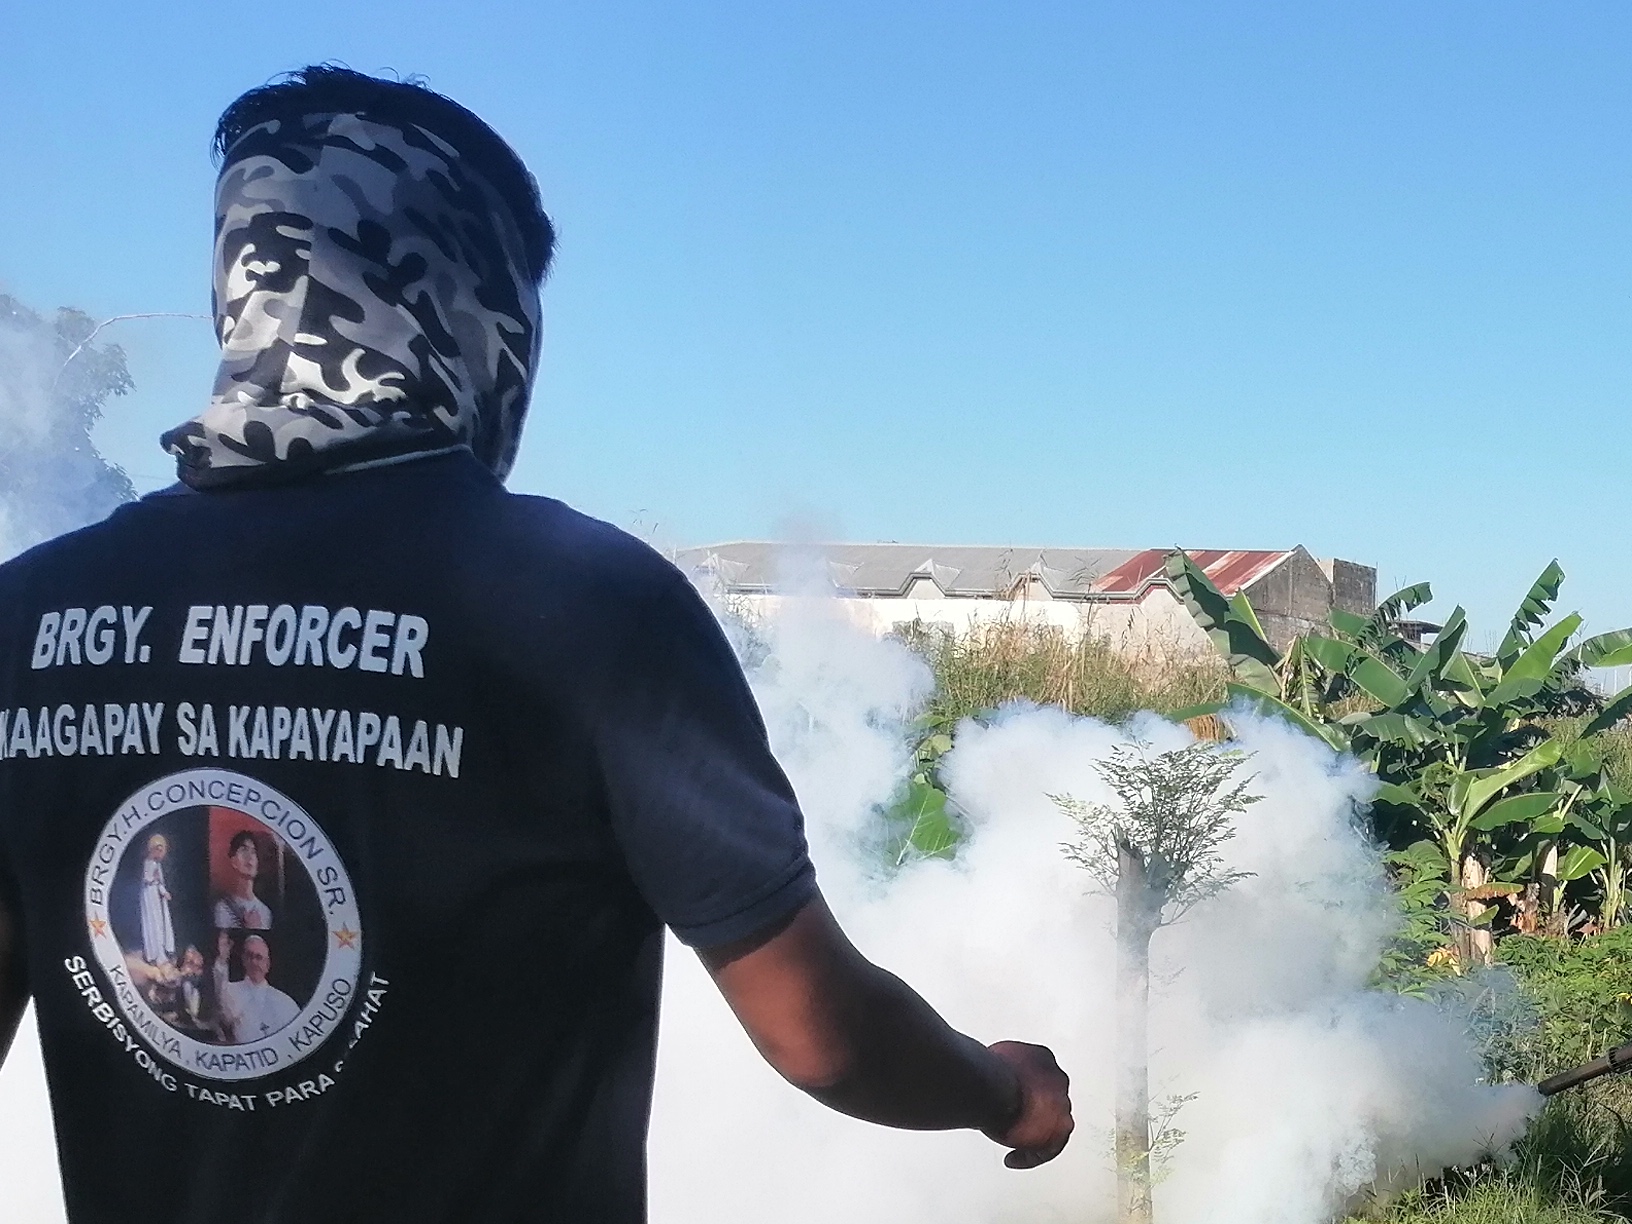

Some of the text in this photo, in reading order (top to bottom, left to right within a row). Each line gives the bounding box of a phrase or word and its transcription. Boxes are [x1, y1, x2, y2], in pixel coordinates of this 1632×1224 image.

[31, 604, 430, 678] BRGY. ENFORCER
[176, 703, 219, 758] SA
[228, 704, 465, 779] KAPAYAPAAN
[316, 865, 347, 915] SR.
[64, 955, 178, 1092] SERBISYONG
[183, 1082, 257, 1112] TAPAT
[265, 1073, 336, 1108] PARA
[288, 977, 352, 1053] KAPUSO
